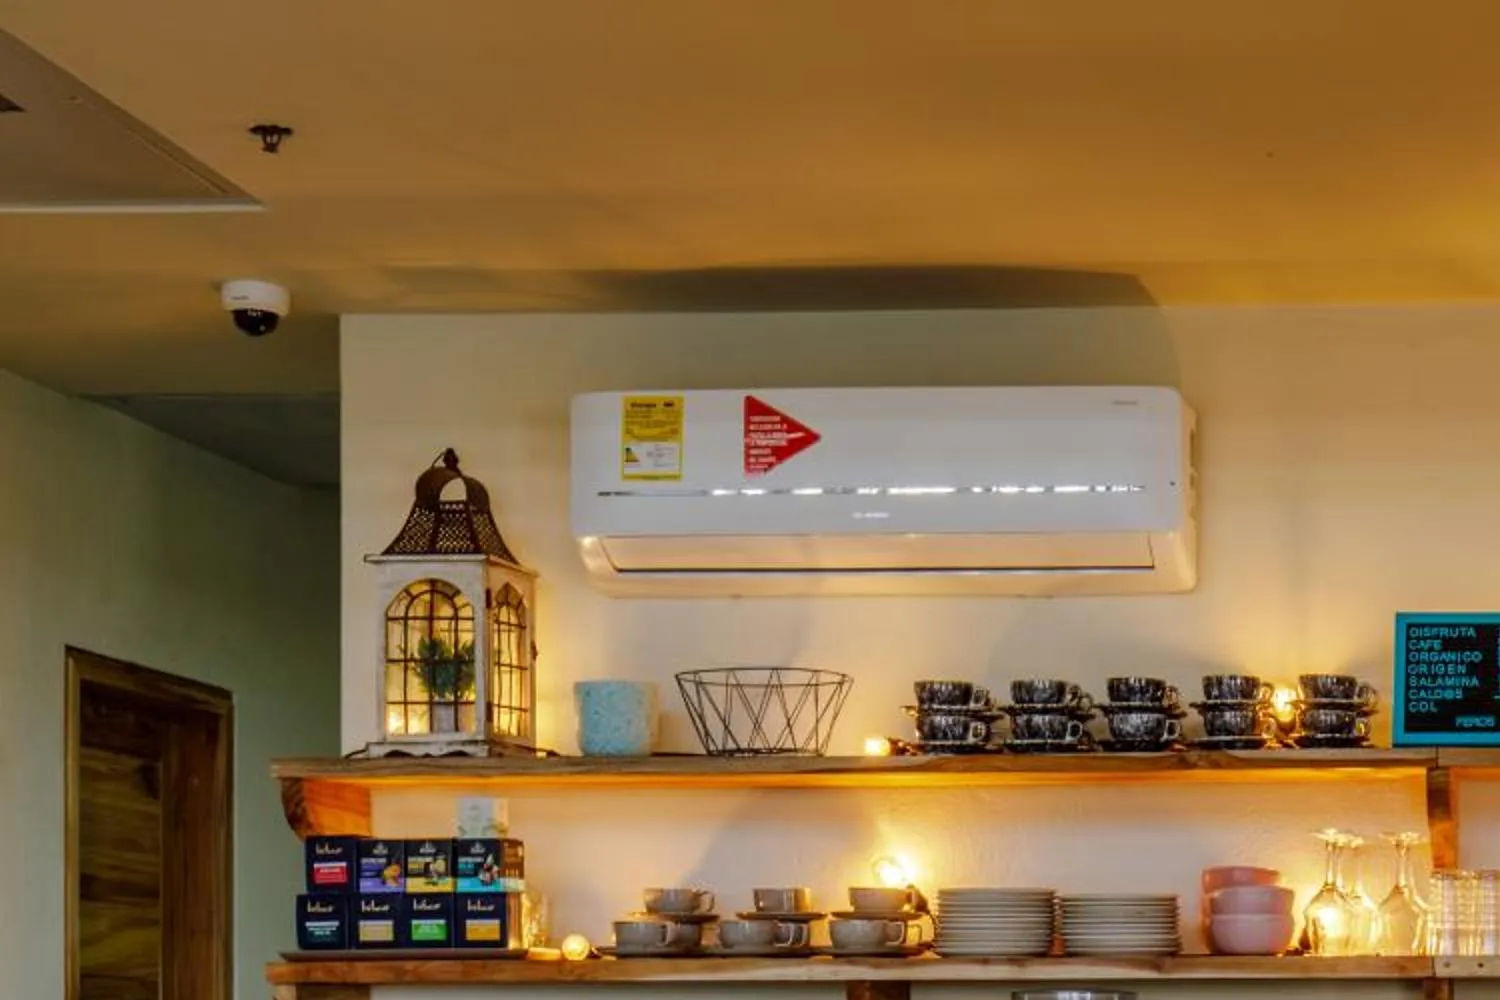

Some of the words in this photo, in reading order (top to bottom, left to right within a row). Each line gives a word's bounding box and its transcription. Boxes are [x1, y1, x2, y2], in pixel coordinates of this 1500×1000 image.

[1409, 627, 1477, 638] DISFRUTA
[1408, 640, 1442, 650] CAFE
[1408, 651, 1483, 663] ORGANICO
[1408, 663, 1467, 675] ORIGEN
[1409, 675, 1480, 688] SALAMINA
[1408, 701, 1438, 713] COL
